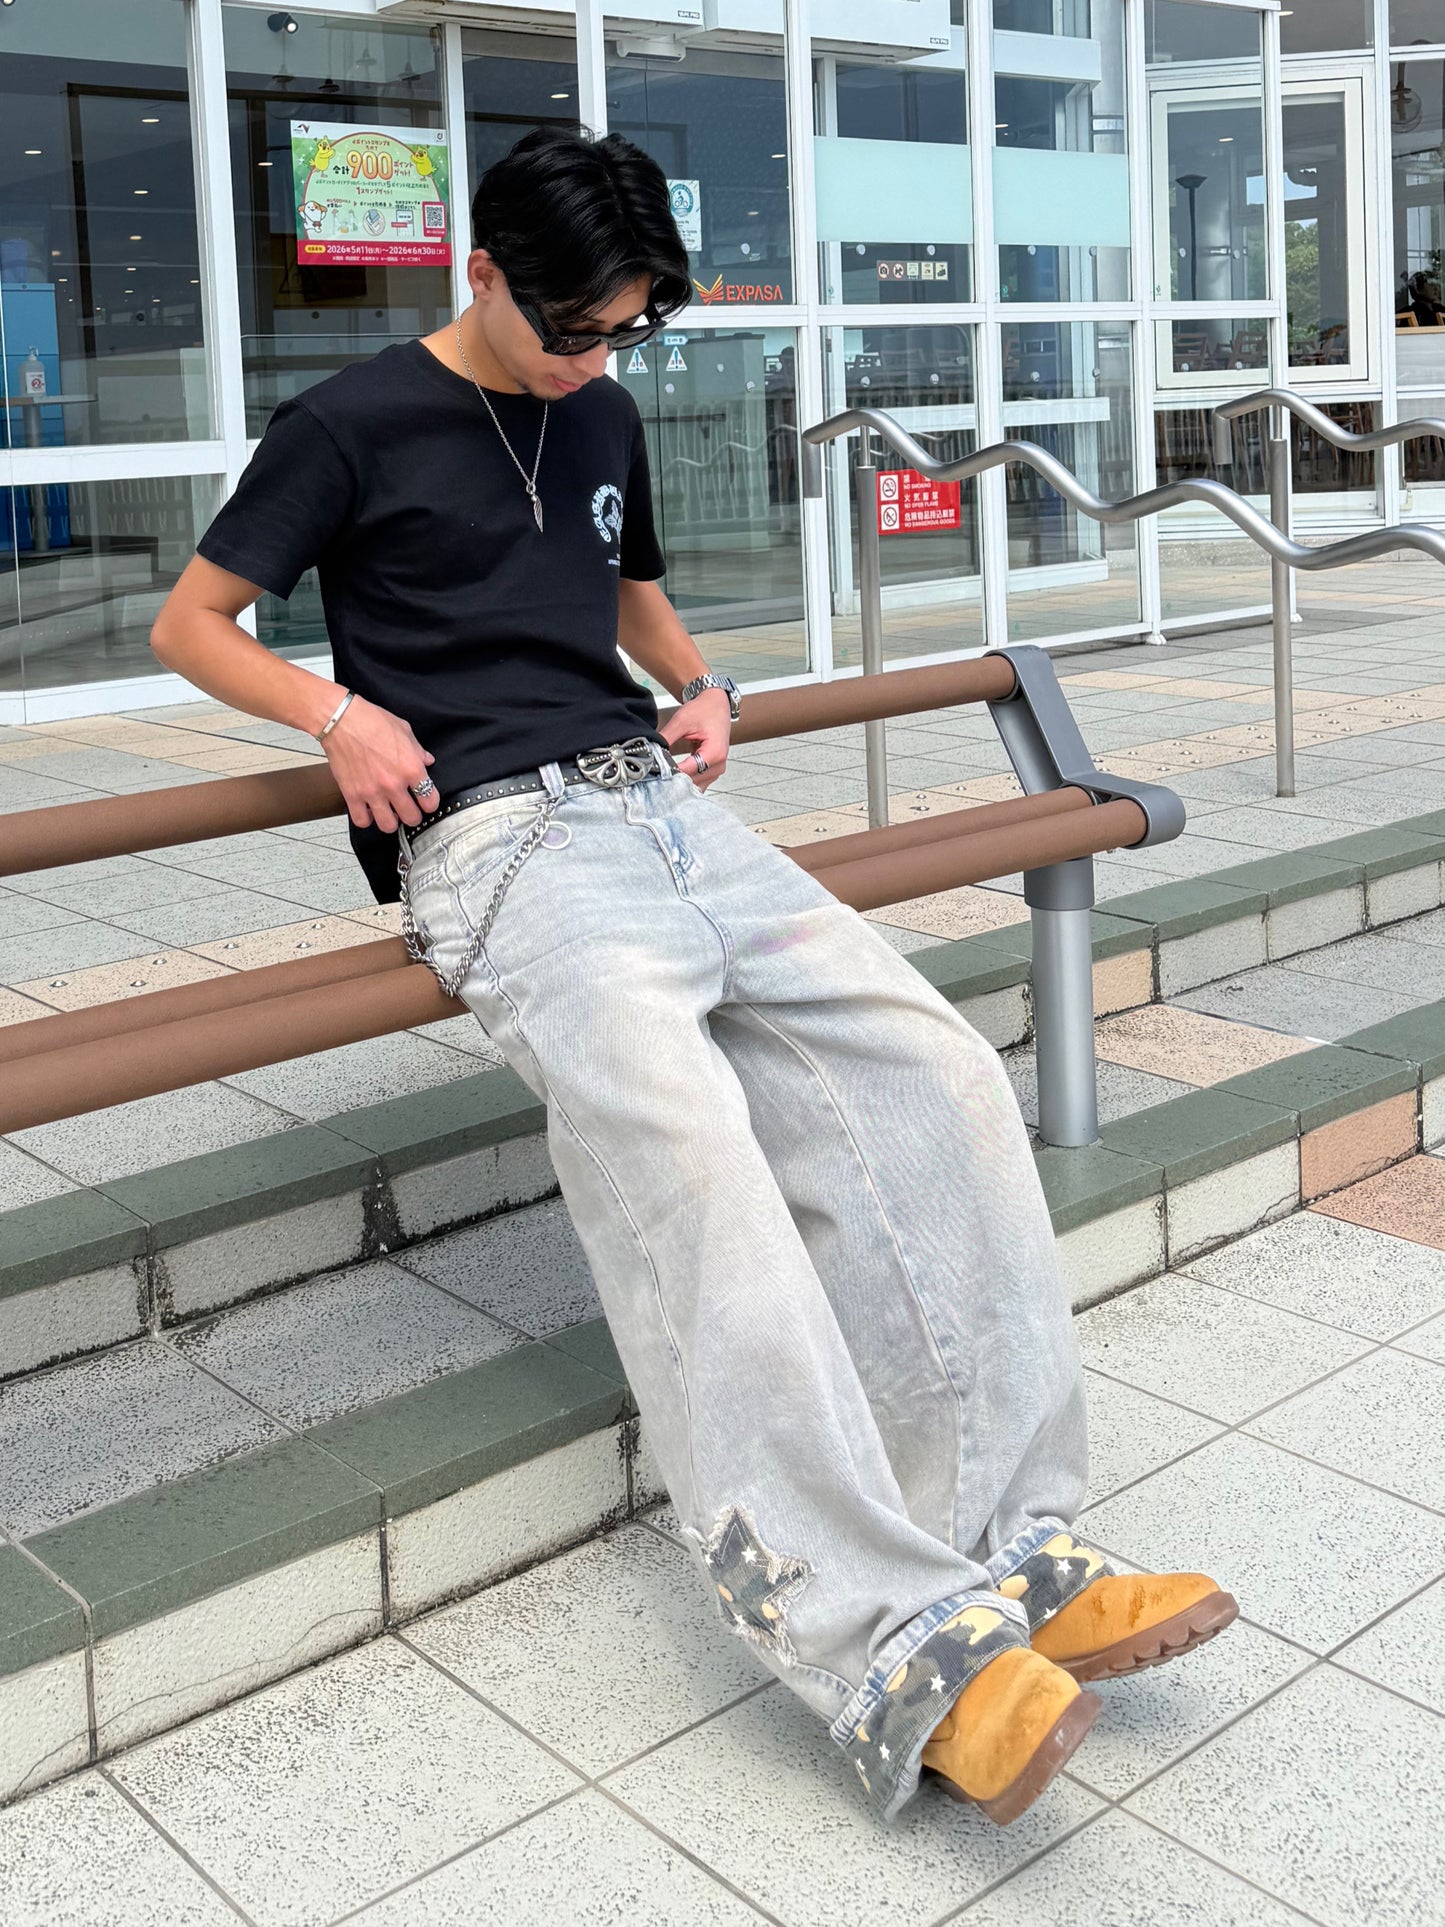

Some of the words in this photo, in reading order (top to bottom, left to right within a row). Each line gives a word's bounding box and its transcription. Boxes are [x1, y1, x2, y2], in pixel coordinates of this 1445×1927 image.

[346, 149, 393, 180] 900
[726, 284, 784, 301] EXPASA
[904, 491, 938, 502] 火気厳禁
[912, 519, 939, 527] DANGEROUS
